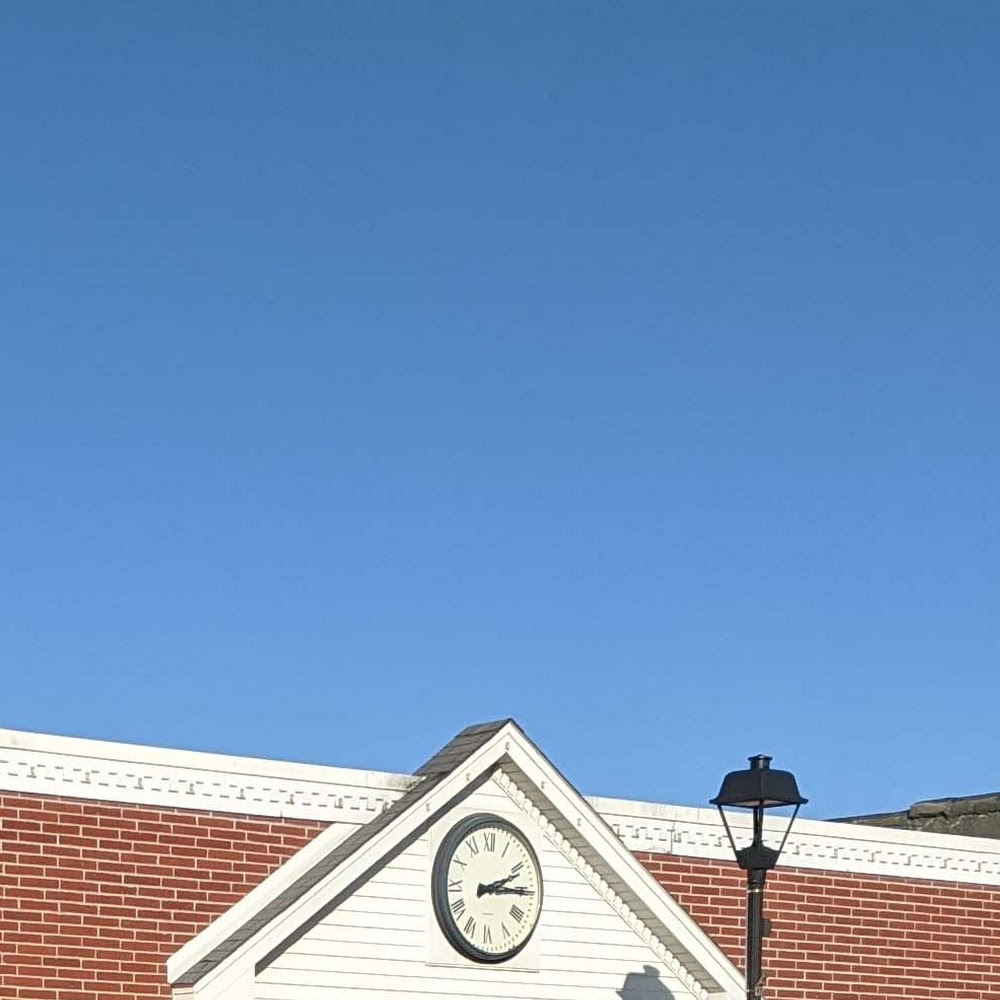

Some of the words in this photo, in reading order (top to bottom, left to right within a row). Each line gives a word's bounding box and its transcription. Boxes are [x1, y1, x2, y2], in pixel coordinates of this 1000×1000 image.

[466, 836, 479, 858] XI
[484, 833, 496, 852] XII
[453, 854, 468, 871] X
[448, 879, 463, 892] IX
[483, 924, 492, 944] VI
[501, 921, 511, 940] V
